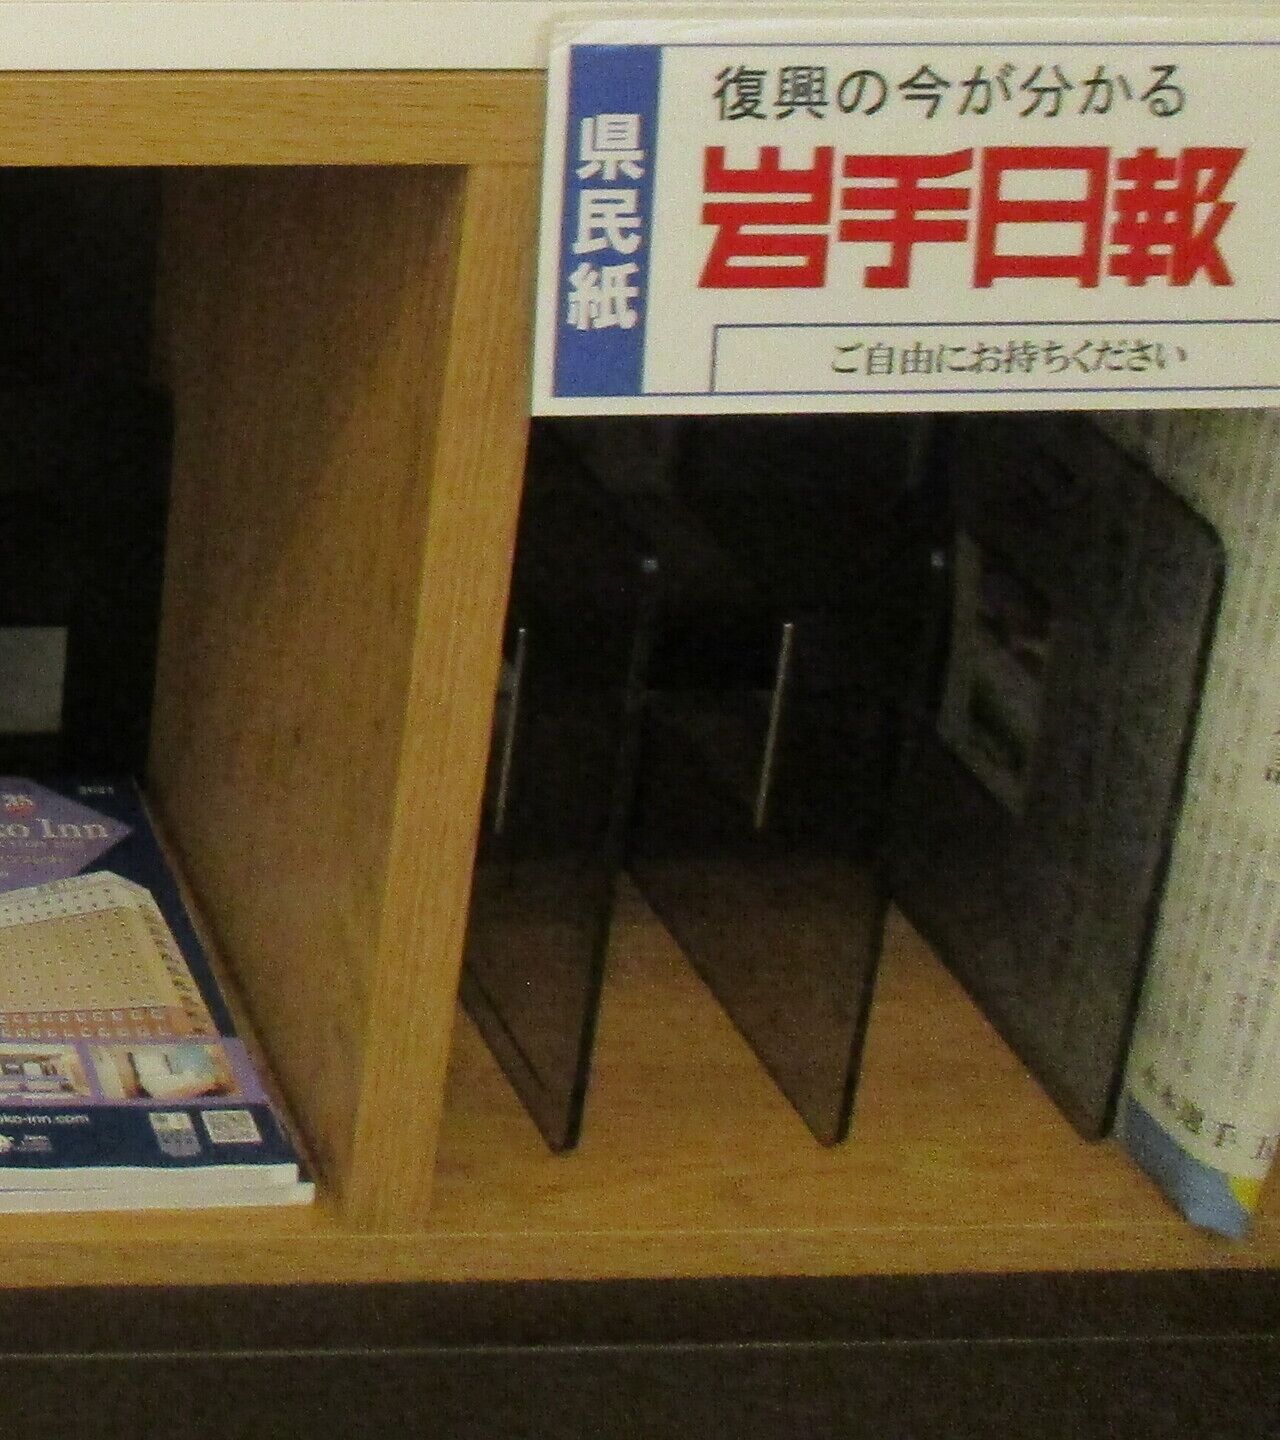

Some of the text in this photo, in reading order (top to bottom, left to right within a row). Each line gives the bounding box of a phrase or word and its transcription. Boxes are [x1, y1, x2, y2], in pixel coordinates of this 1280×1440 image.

[712, 62, 1187, 121] 復興の今が分かる
[565, 111, 645, 331] 県民紙
[698, 144, 1248, 289] 岩手日報
[830, 340, 1189, 376] ご自由にお持ちください
[40, 817, 111, 840] Inn
